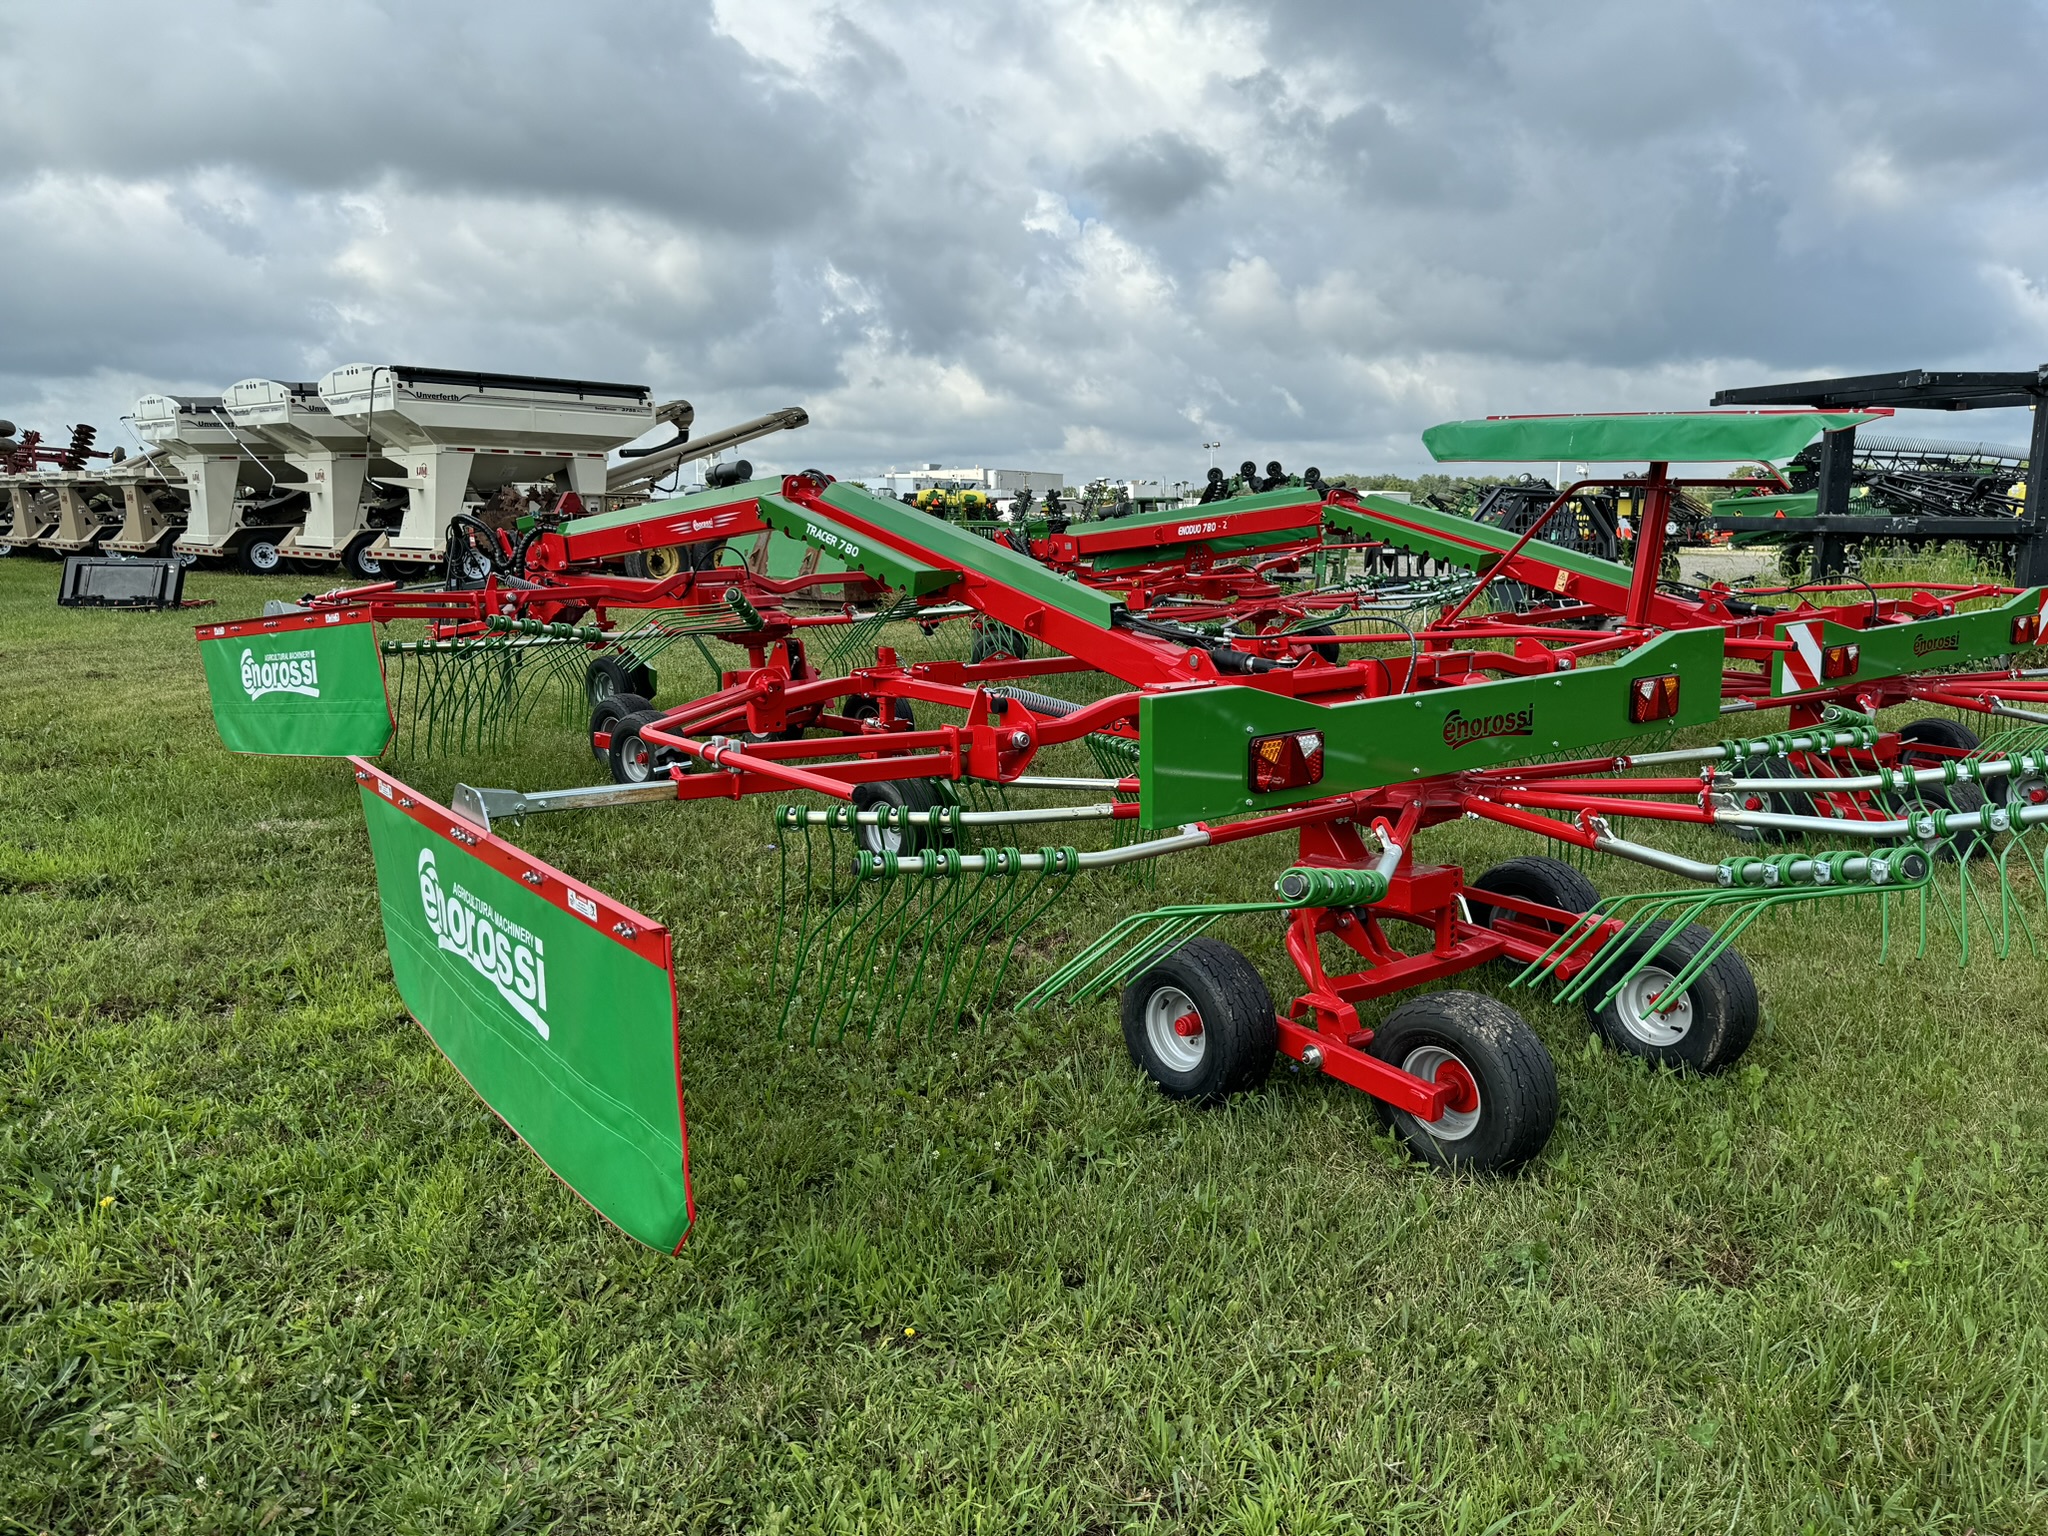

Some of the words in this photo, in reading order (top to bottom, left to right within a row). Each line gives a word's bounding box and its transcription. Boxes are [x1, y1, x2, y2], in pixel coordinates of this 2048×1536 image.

[416, 391, 459, 402] Unverferth
[806, 522, 838, 548] TRACER
[838, 539, 859, 557] 780
[1178, 523, 1202, 536] ENODUO
[1202, 521, 1217, 534] 780
[1222, 520, 1228, 530] 2
[1442, 703, 1534, 746] enorossi
[452, 881, 496, 923] AGRICULTURAL
[494, 912, 534, 948] MACHINERY
